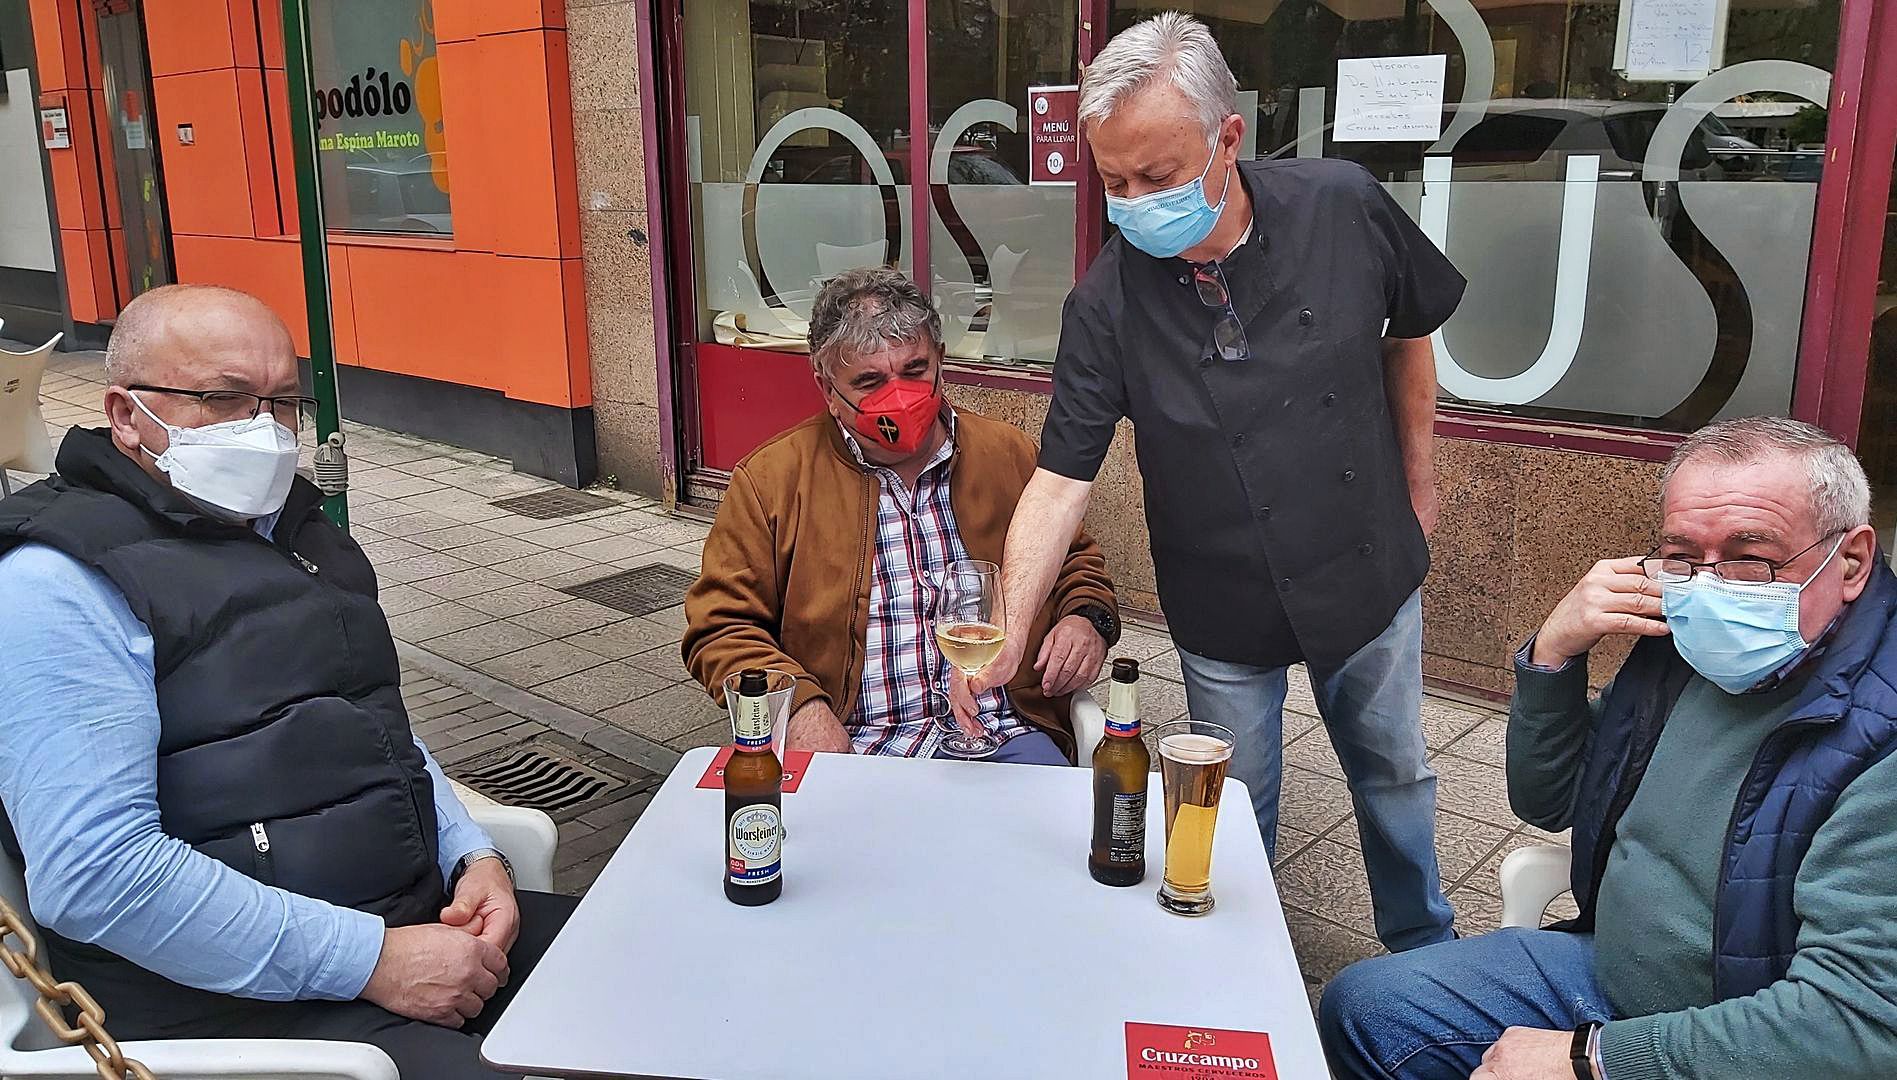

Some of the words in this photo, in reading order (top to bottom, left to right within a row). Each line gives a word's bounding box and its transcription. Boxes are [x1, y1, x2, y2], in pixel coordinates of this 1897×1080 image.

[1371, 60, 1420, 71] Horario
[1344, 75, 1369, 88] De
[1375, 90, 1385, 98] 5
[1042, 120, 1069, 133] MENÚ
[336, 132, 374, 152] Espina
[376, 131, 420, 148] Maroto
[1036, 135, 1053, 143] PARA
[1053, 135, 1075, 143] LLEVAR
[752, 701, 761, 737] Warsteiner
[735, 825, 777, 841] Warsteiner
[747, 869, 770, 877] FRESH
[1141, 1047, 1260, 1071] Cruzcampo
[1138, 1063, 1195, 1073] MAESTROS
[1197, 1068, 1267, 1078] CERVECEROS
